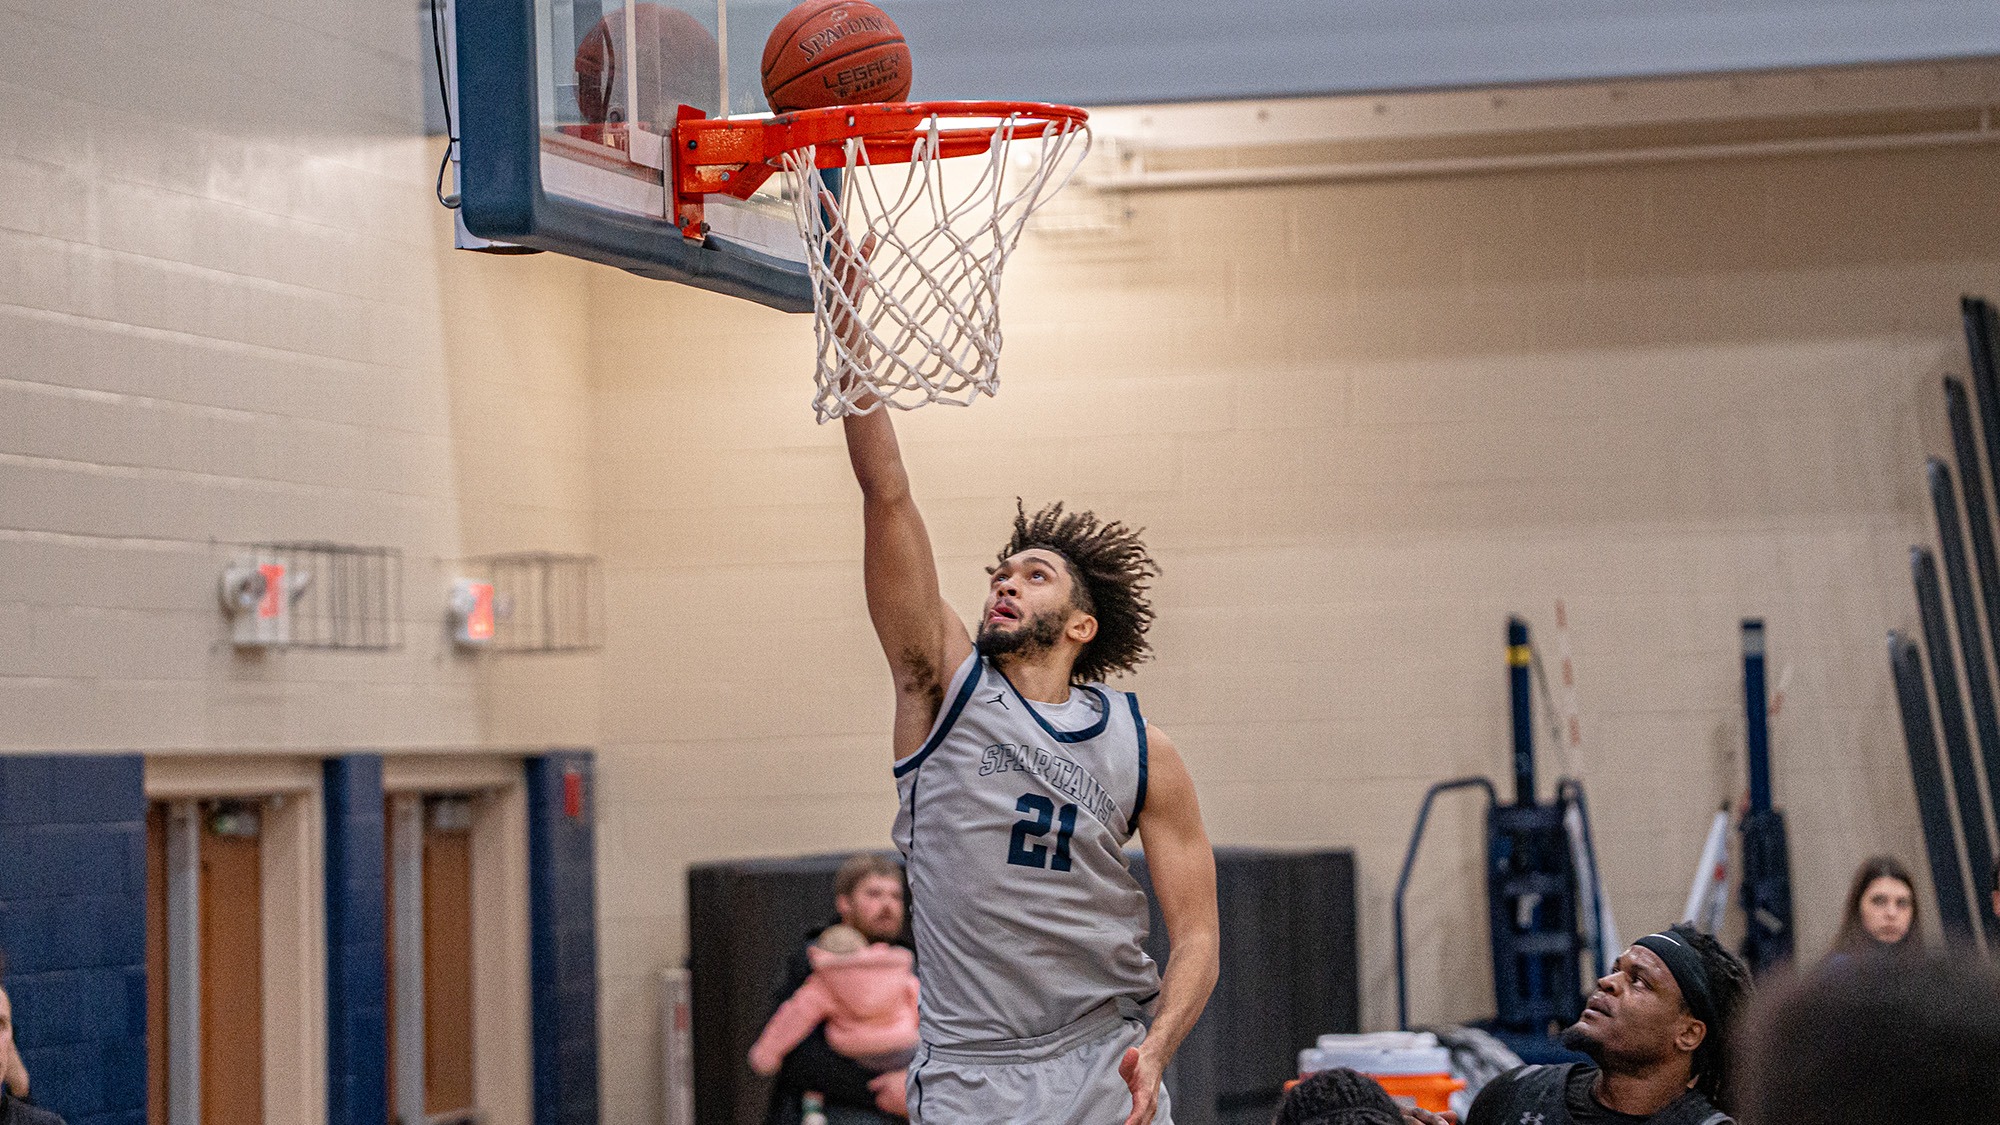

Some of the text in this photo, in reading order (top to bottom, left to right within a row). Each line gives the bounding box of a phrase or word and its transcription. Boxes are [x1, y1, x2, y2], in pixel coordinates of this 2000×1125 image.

[822, 54, 900, 89] LEGACY
[979, 744, 1116, 826] SPARTANS
[1007, 793, 1077, 872] 21
